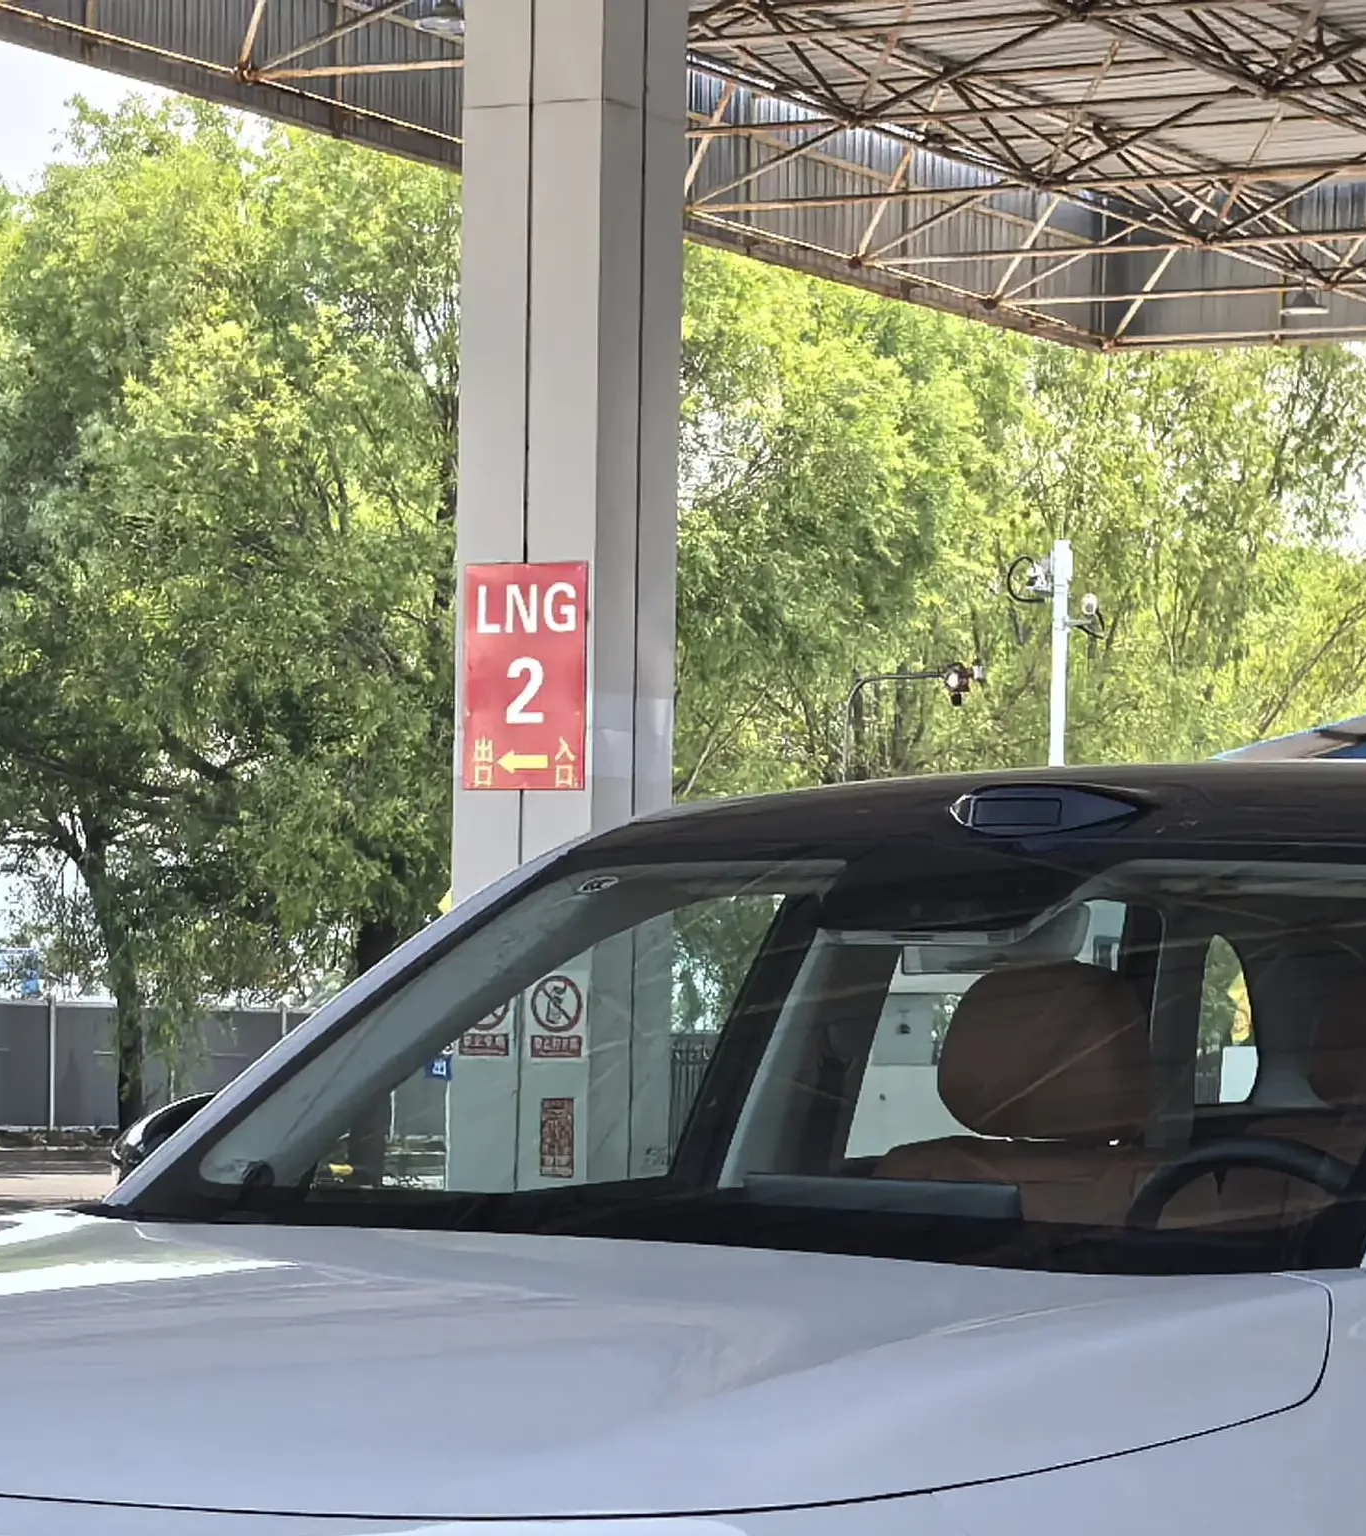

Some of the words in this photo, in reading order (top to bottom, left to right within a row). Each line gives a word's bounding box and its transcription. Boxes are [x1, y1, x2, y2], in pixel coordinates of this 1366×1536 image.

[477, 582, 577, 634] LNG
[505, 656, 545, 725] 2
[473, 736, 495, 788] 出口
[554, 736, 576, 788] 入口
